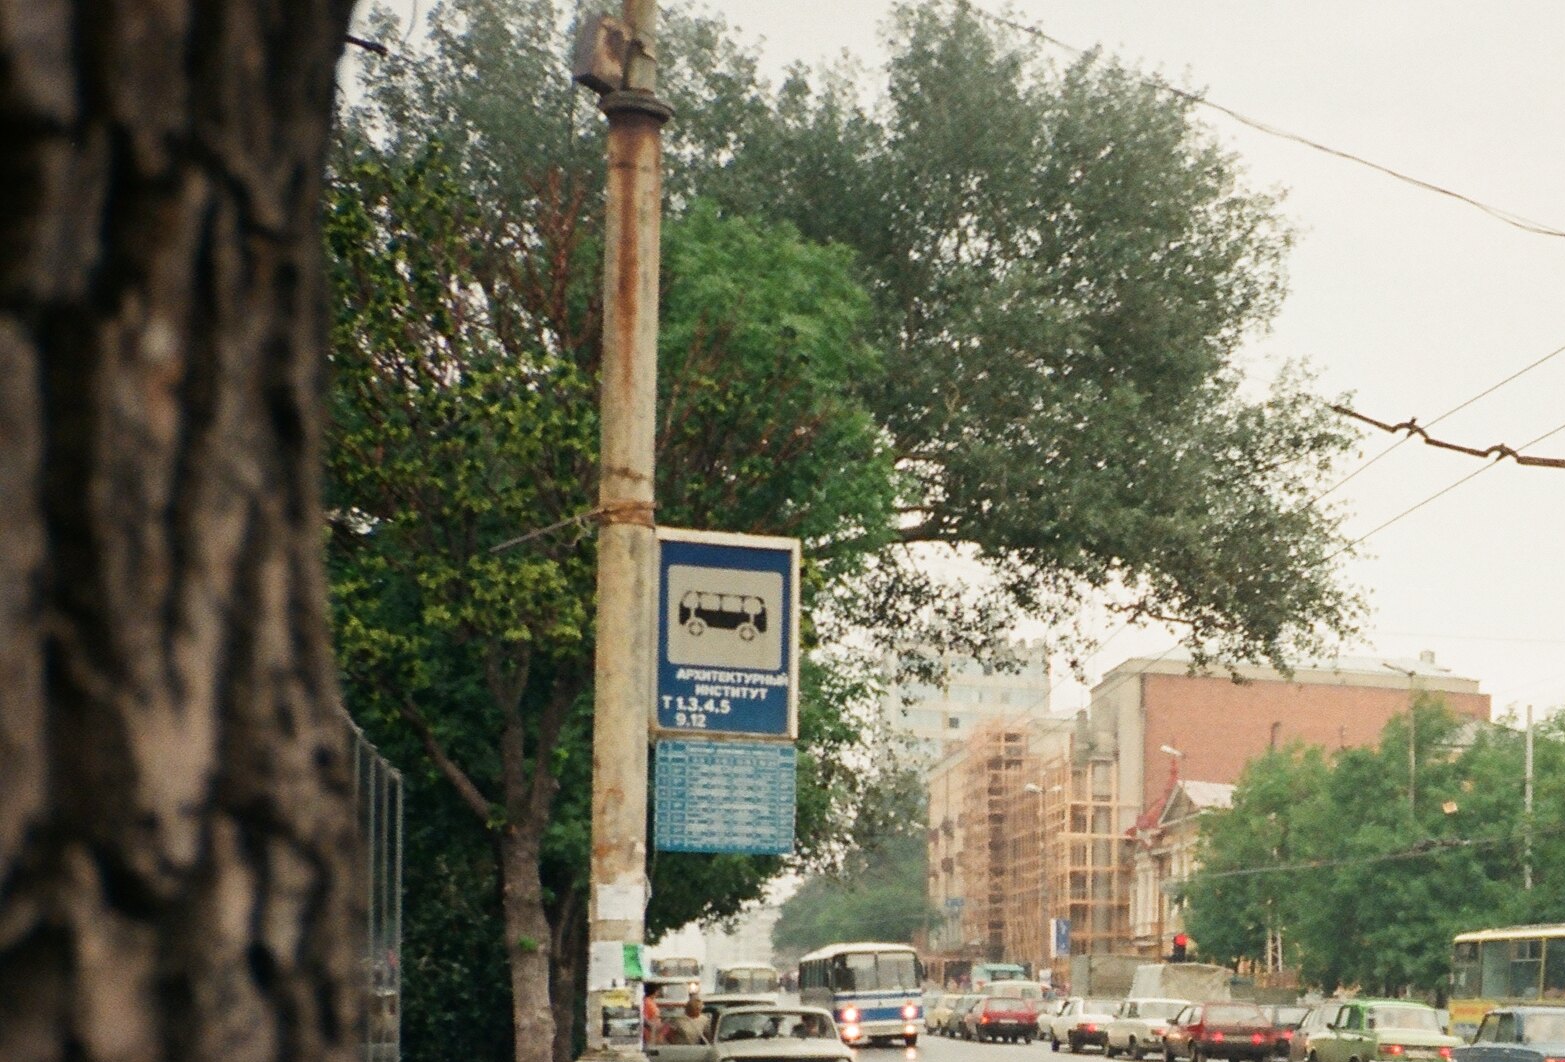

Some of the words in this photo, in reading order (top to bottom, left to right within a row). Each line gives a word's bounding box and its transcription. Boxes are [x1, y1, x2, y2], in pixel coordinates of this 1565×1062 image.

[676, 668, 788, 686] АРХИТЕКТУРНЫЙ
[695, 684, 768, 700] ИНСТИТУТ
[662, 695, 672, 709] Т
